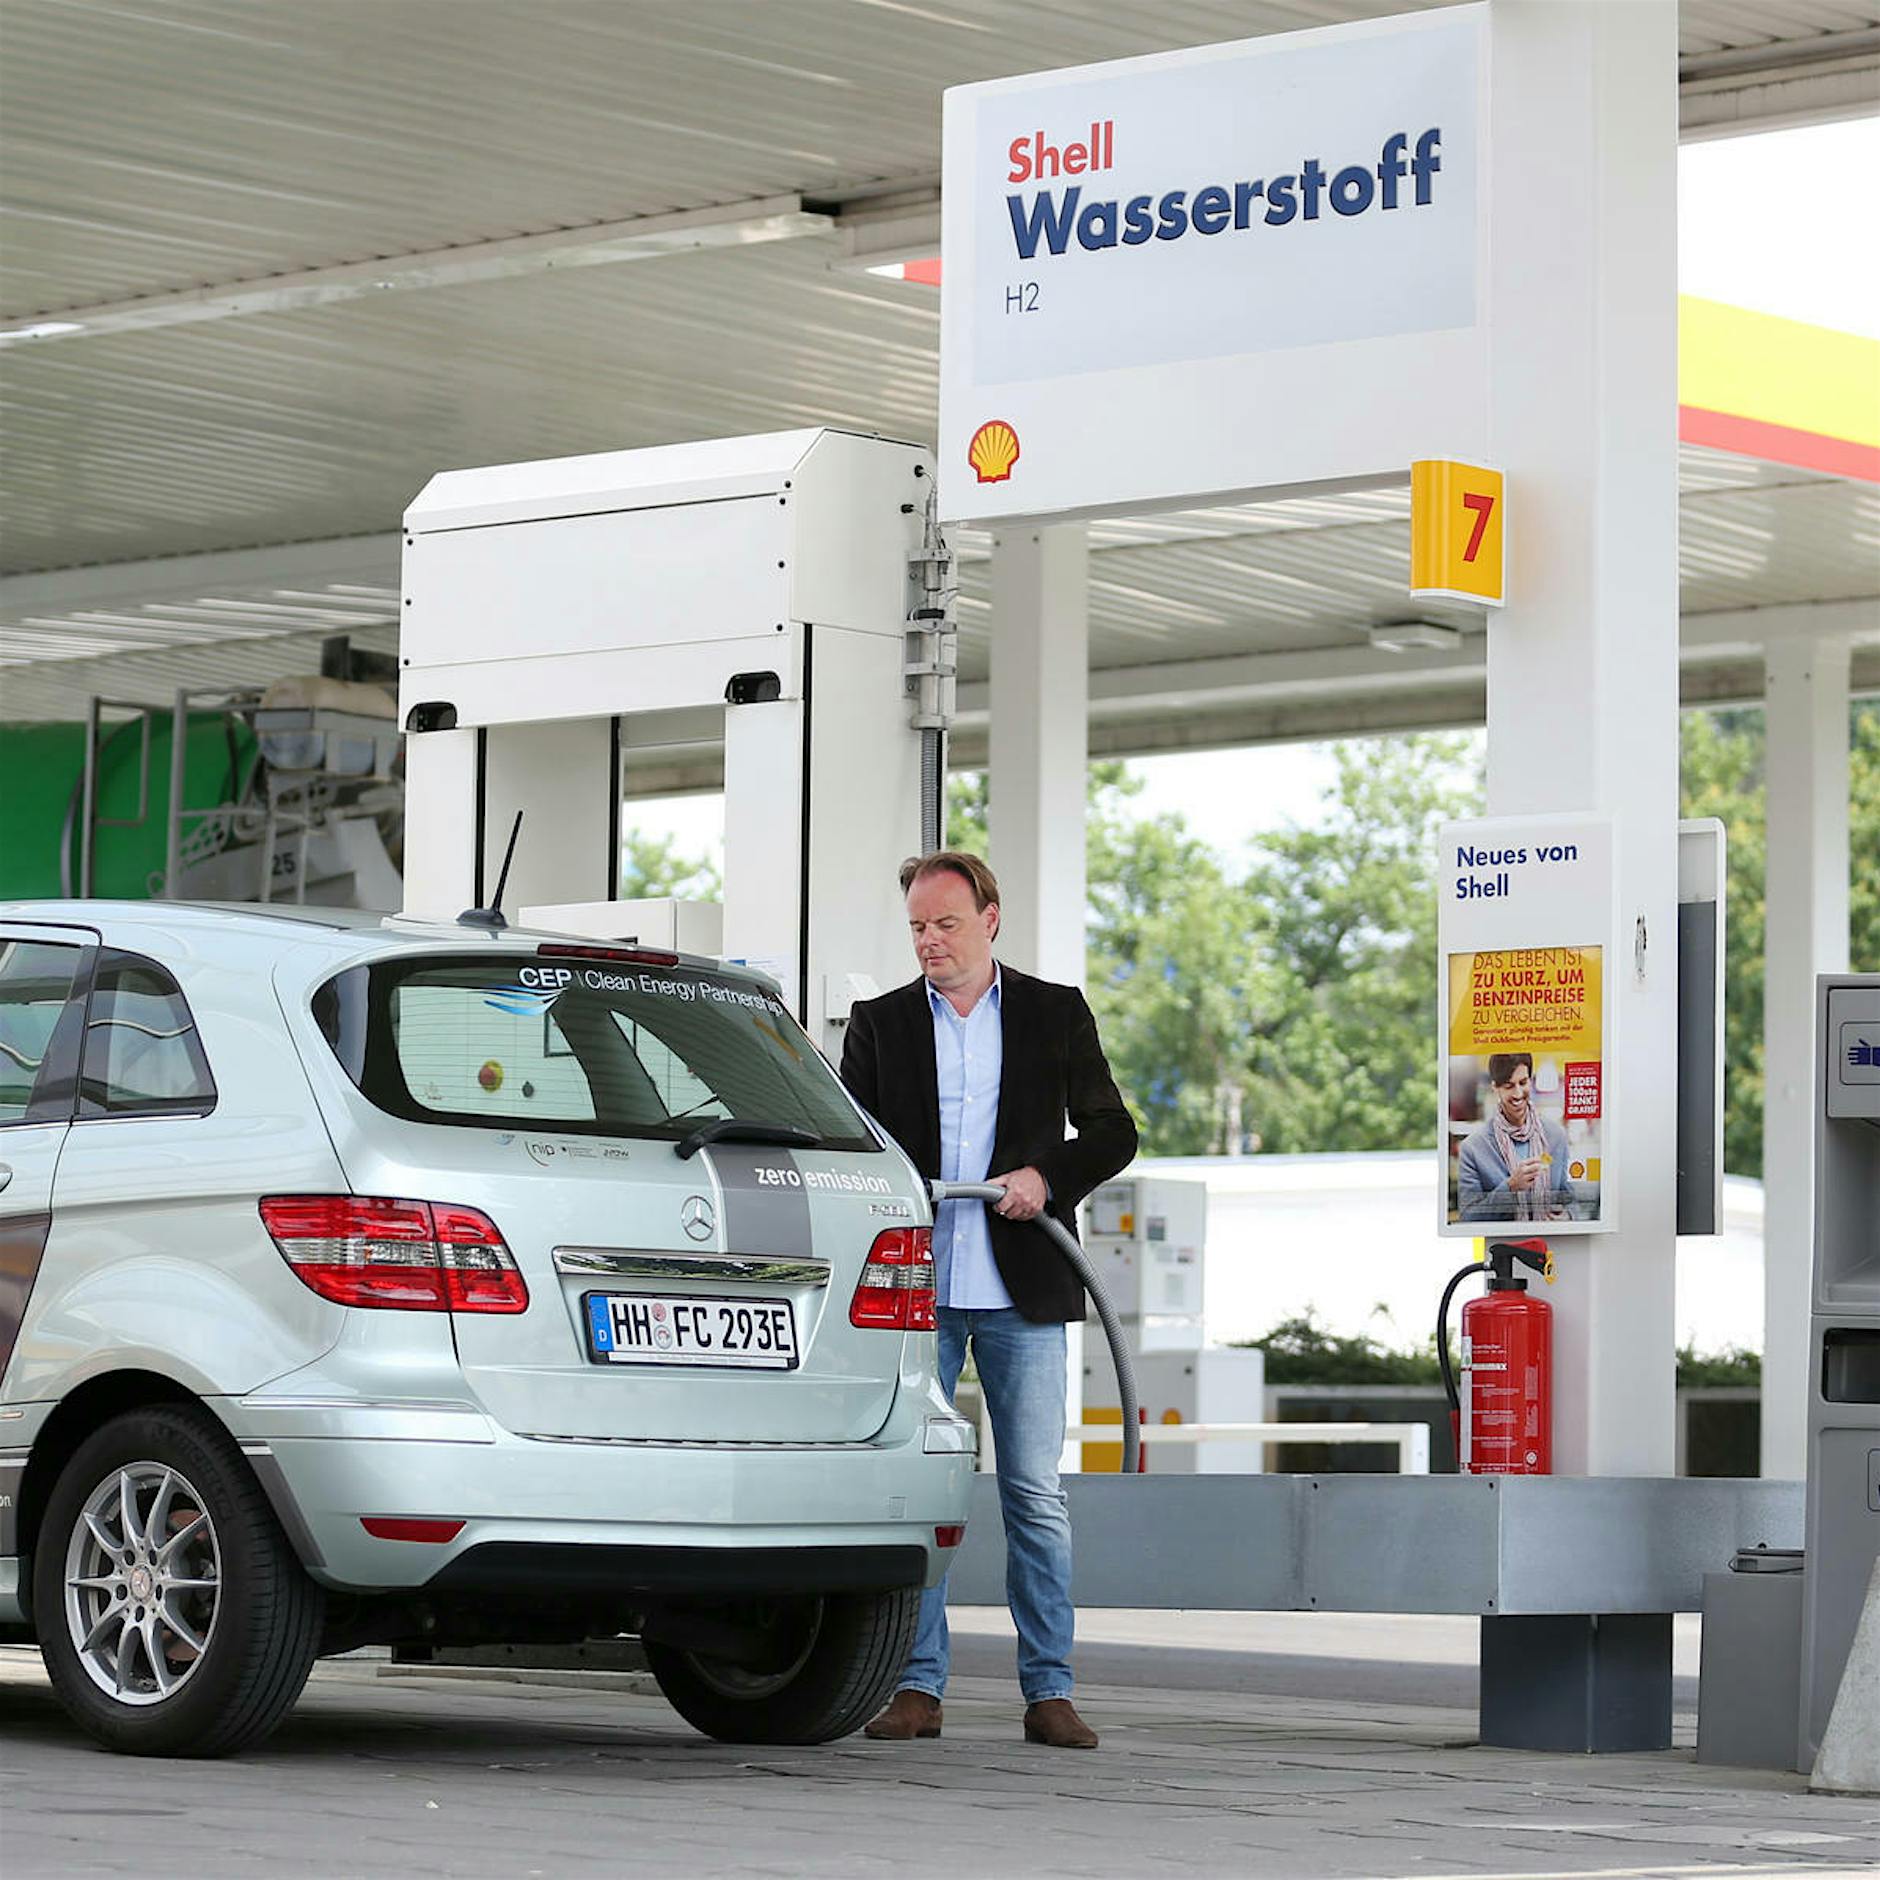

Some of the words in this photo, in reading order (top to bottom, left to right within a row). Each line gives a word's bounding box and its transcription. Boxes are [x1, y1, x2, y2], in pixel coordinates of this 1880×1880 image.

[1007, 120, 1114, 184] Shell
[1006, 128, 1442, 260] Wasserstoff
[1006, 282, 1040, 315] H2
[1463, 492, 1494, 562] 7
[1457, 846, 1527, 868] Neues
[1535, 845, 1578, 862] von
[1456, 873, 1509, 899] Shell
[1473, 952, 1503, 970] DAS
[1510, 949, 1556, 968] LEBEN
[1563, 948, 1582, 966] IST
[1473, 972, 1494, 989] ZU
[1501, 970, 1551, 987] KURZ,
[1557, 968, 1584, 984] UM
[519, 967, 572, 988] CEP
[584, 969, 636, 991] Clean
[638, 974, 696, 1001] Energy
[699, 982, 784, 1018] Partnership
[1473, 987, 1584, 1007] BENZINPREISE
[1473, 1010, 1490, 1025] ZU
[1495, 1006, 1584, 1024] VERGLEICHEN.
[754, 1167, 801, 1187] zero
[804, 1168, 892, 1193] emission
[599, 1329, 607, 1342] D
[611, 1303, 653, 1346] HH
[673, 1306, 712, 1348] FC
[719, 1308, 791, 1351] 293E
